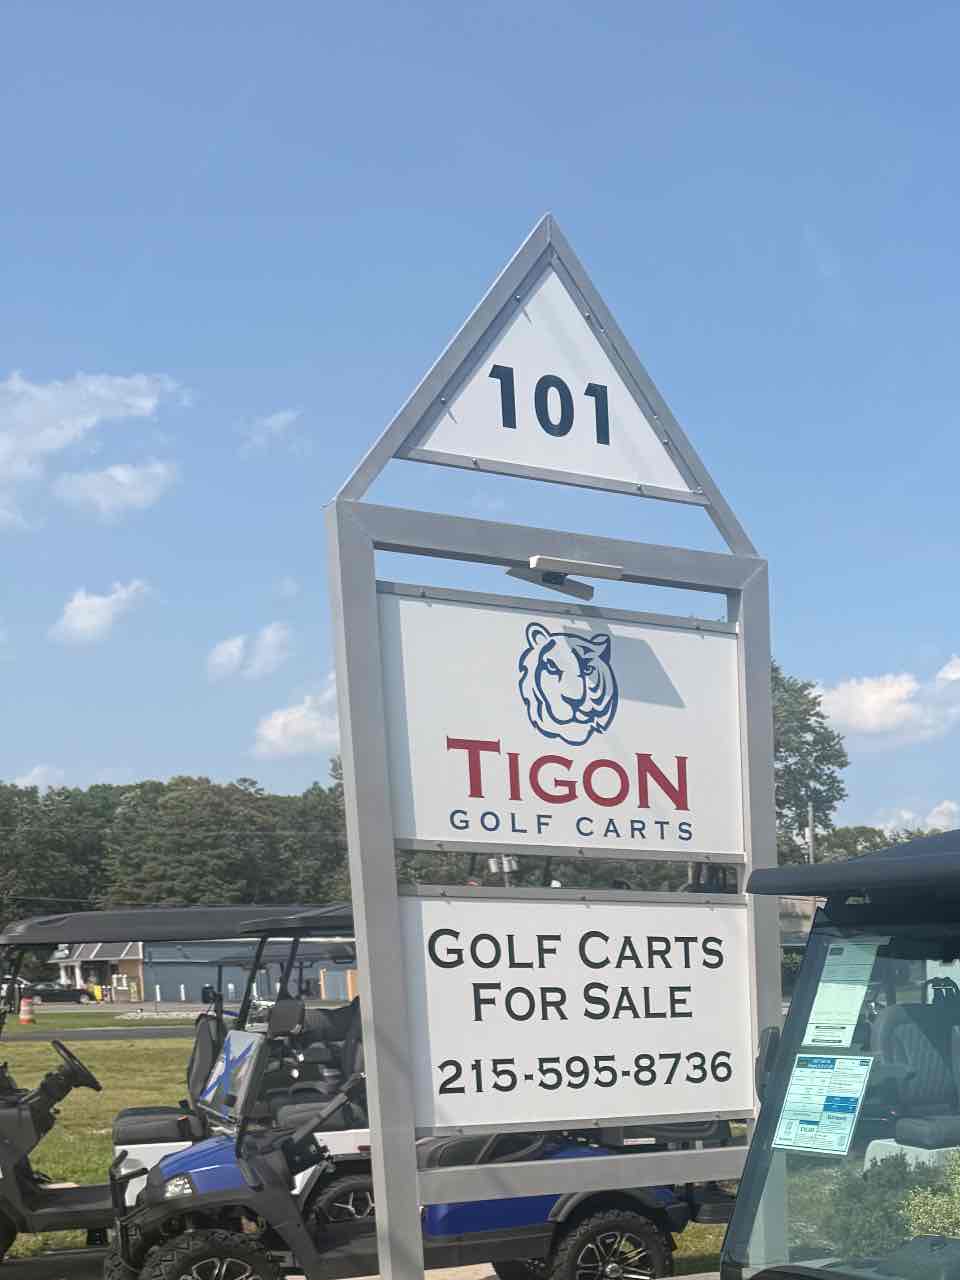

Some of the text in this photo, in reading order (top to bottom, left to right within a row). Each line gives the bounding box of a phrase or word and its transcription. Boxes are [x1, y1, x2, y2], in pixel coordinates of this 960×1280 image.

[488, 364, 611, 446] 101
[446, 735, 690, 811] TIGON
[449, 809, 694, 841] GOLF CARTS
[427, 928, 725, 970] GOLF CARTS
[471, 981, 694, 1022] FOR SALE
[437, 1050, 733, 1095] 215-595-8736
